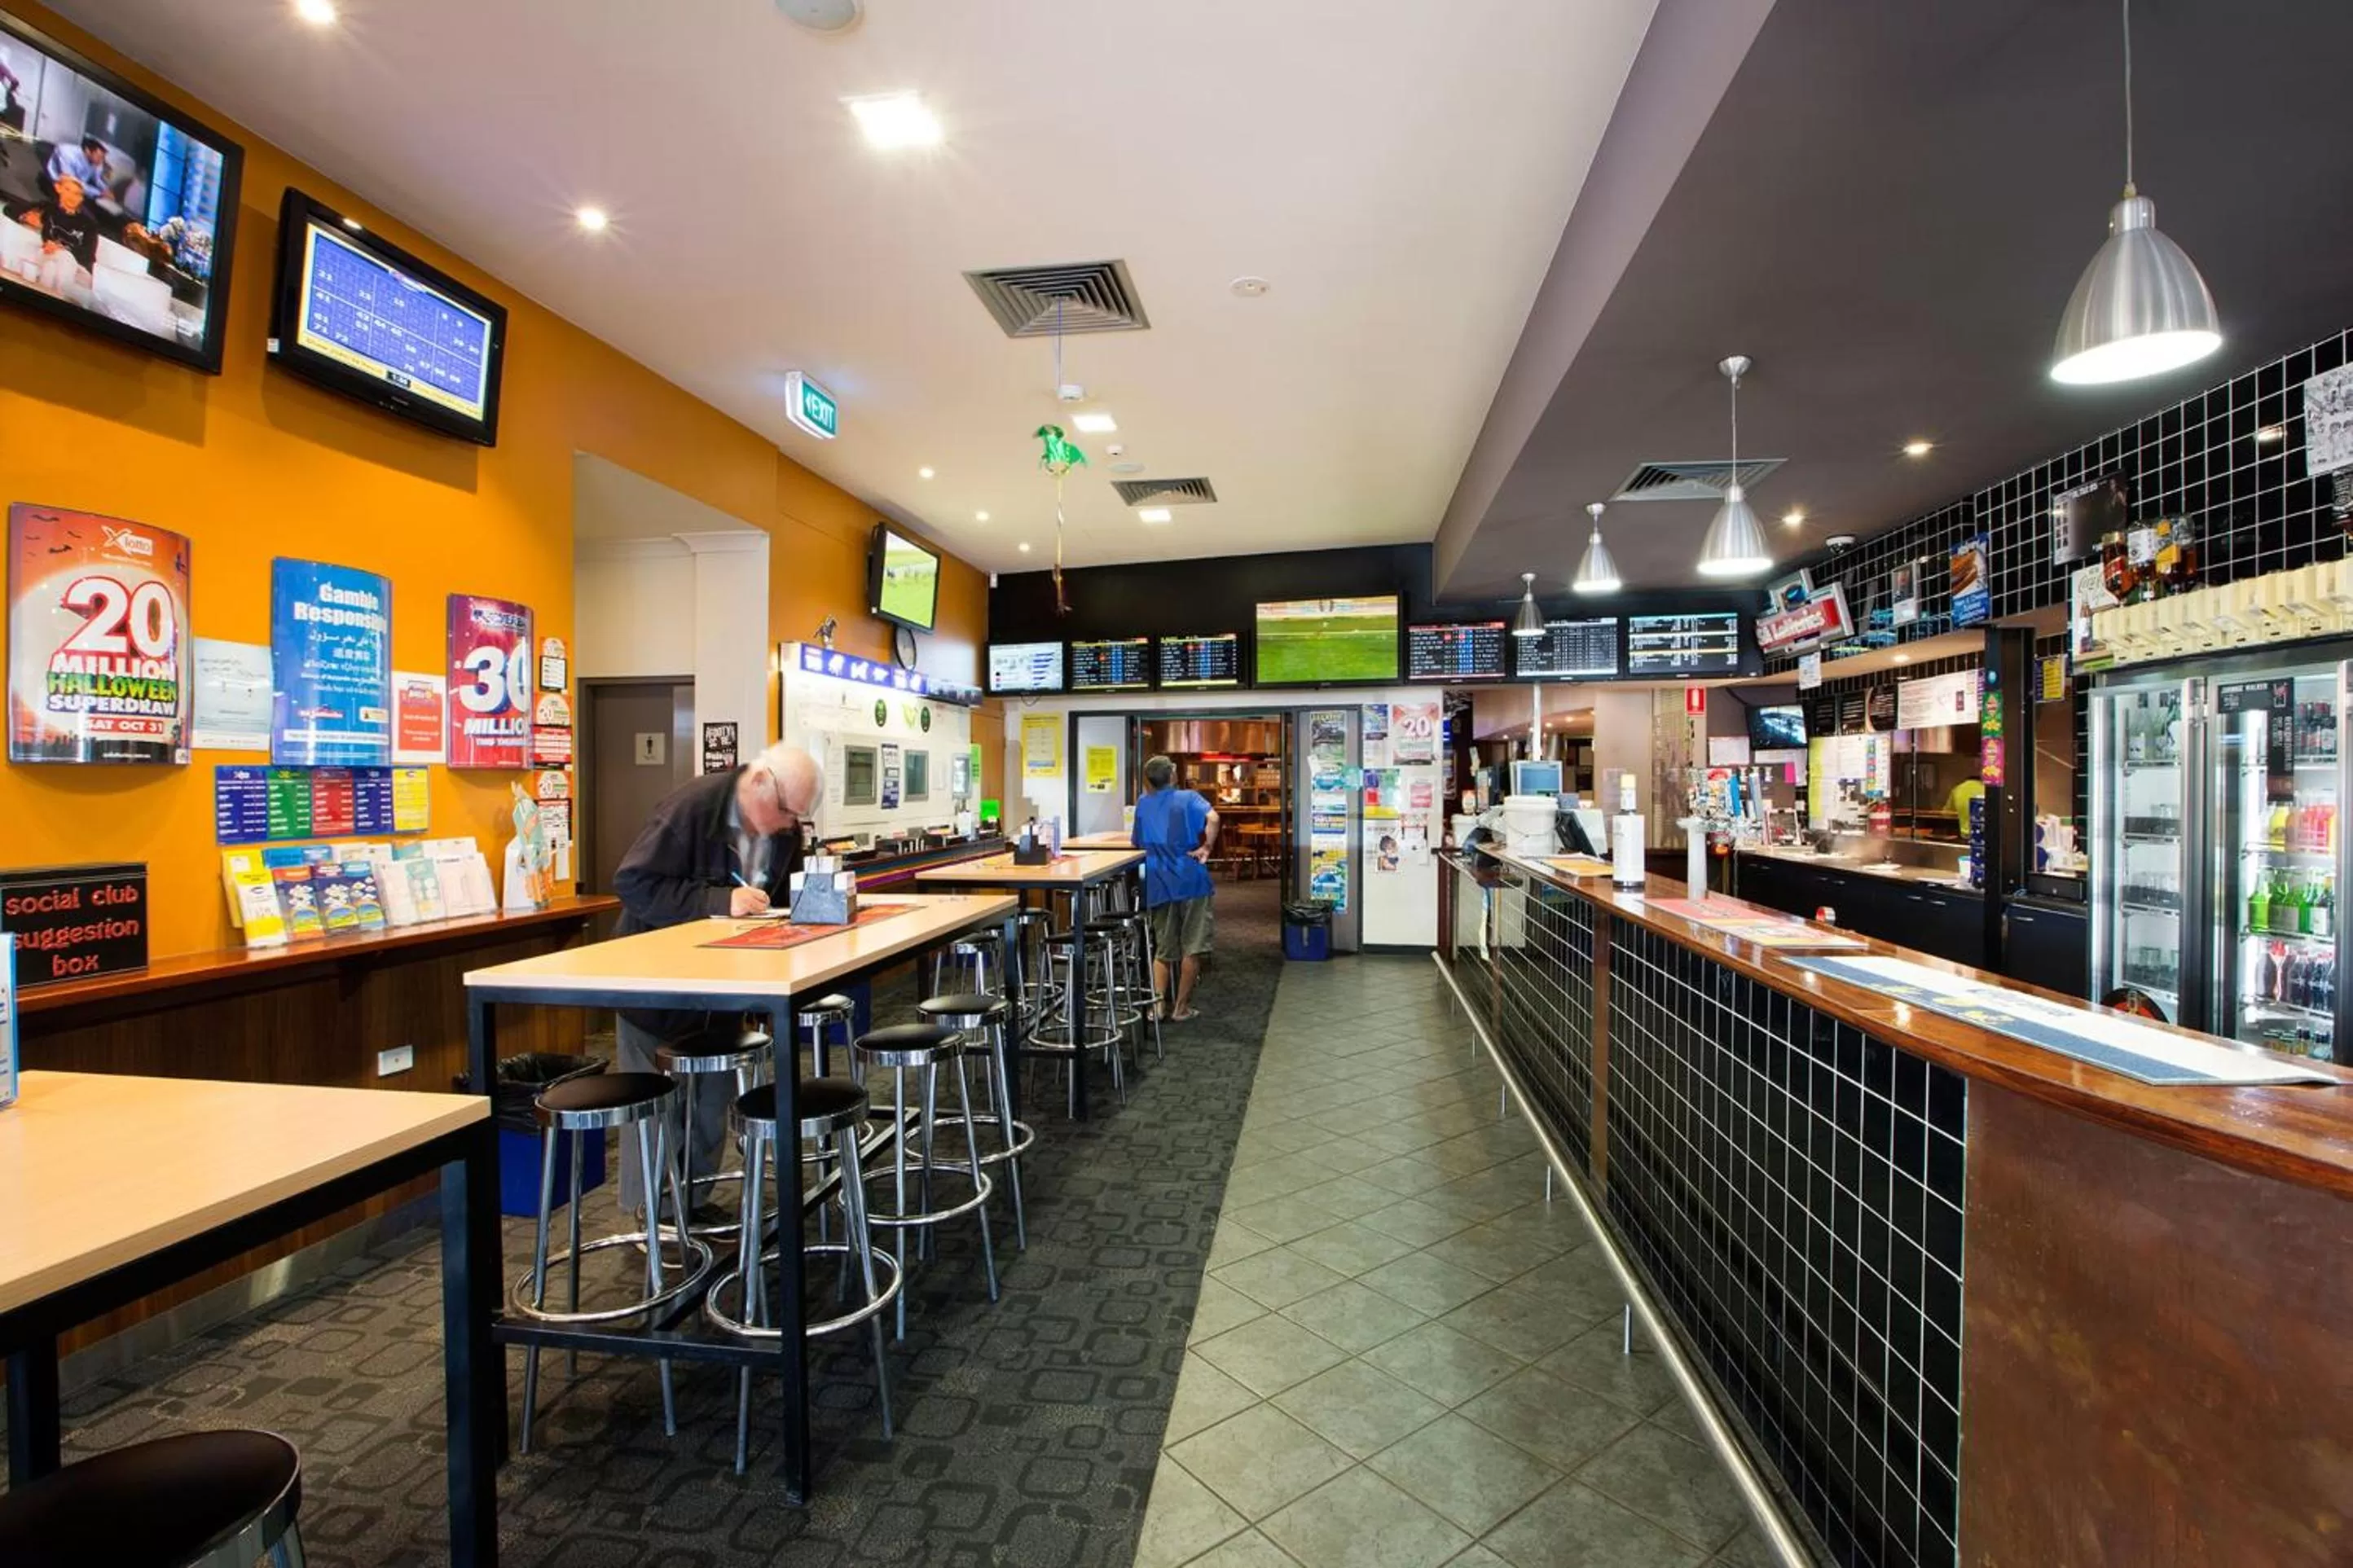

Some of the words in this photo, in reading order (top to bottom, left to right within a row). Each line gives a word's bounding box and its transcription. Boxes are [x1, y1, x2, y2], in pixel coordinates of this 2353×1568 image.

[811, 393, 834, 429] EXIT
[59, 575, 176, 658] 20
[51, 653, 176, 681] MILLION
[47, 671, 177, 703] HALLOWEEN
[49, 694, 176, 717] SUPERDRAW
[119, 720, 147, 731] OCT
[150, 720, 163, 731] 31
[464, 717, 530, 736] MILLIO
[1403, 715, 1432, 737] 20
[6, 887, 81, 915] social
[91, 885, 139, 906] club
[14, 918, 139, 951] suggestion
[52, 955, 99, 977] box
